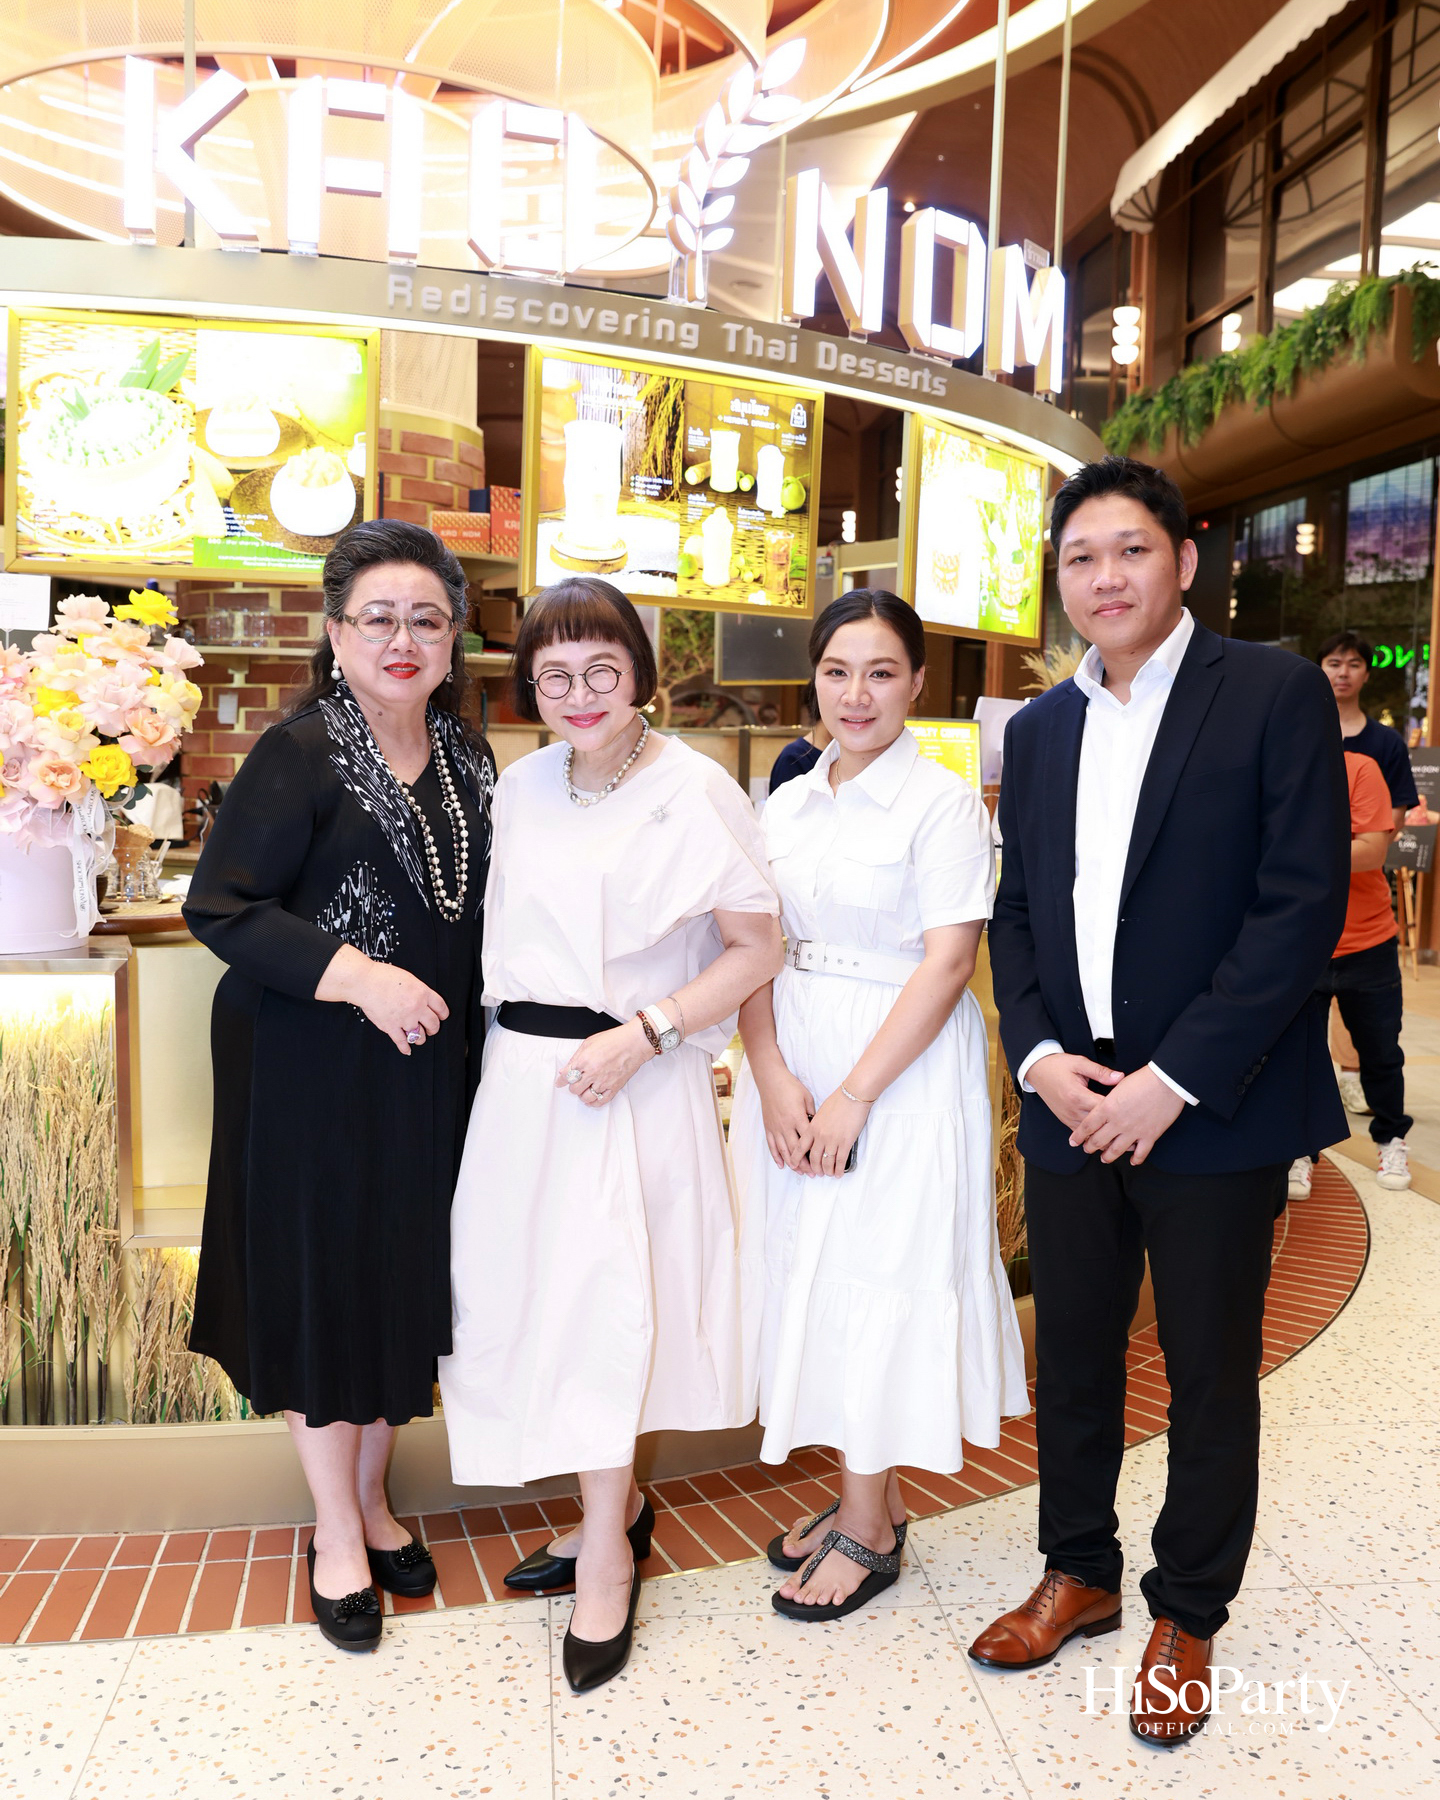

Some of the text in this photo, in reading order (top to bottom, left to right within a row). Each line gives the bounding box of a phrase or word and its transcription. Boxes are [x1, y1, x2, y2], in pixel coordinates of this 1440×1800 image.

[386, 273, 948, 397] Rediscovering Thai Desserts
[778, 167, 1066, 394] NOM
[504, 519, 520, 530] KA
